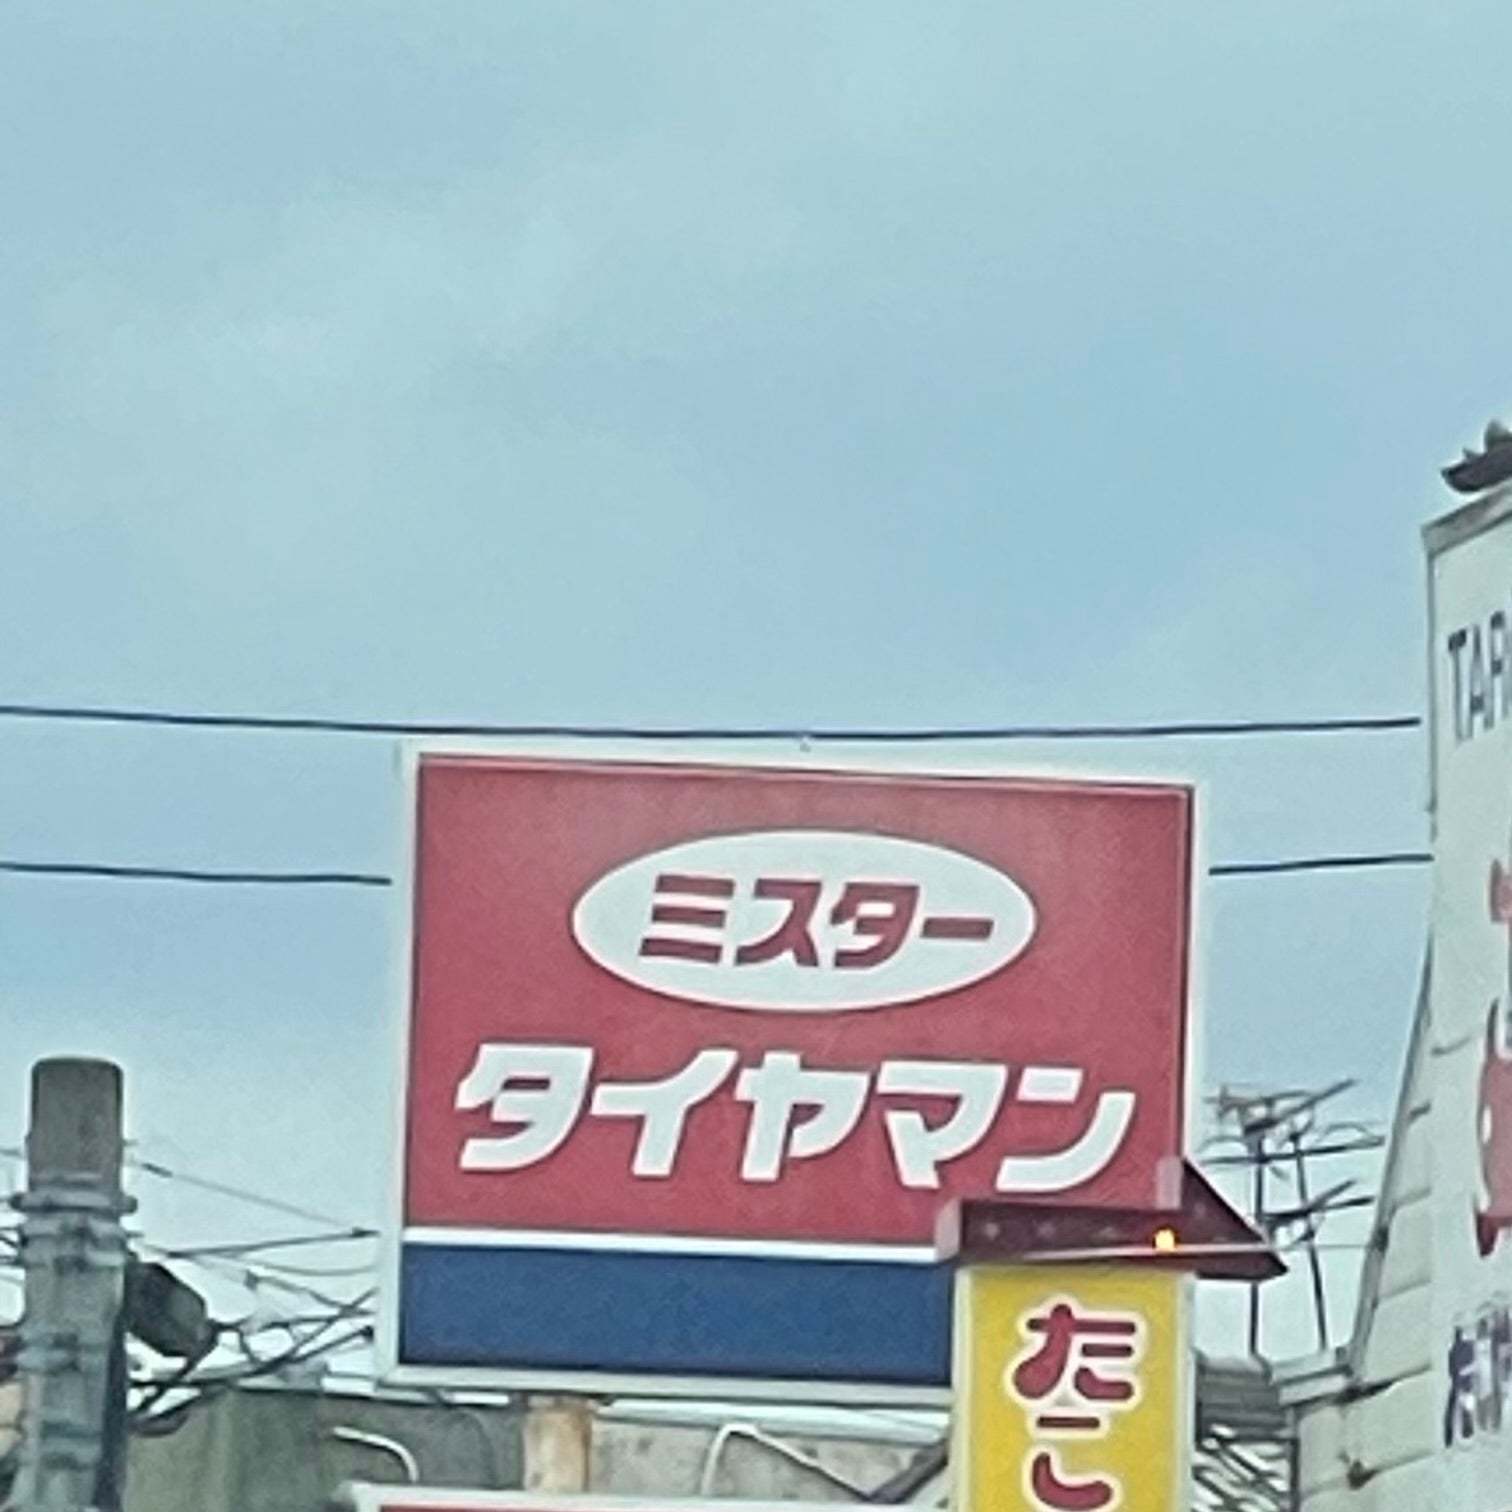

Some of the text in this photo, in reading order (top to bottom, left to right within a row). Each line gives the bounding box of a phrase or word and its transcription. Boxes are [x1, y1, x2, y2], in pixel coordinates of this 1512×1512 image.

[639, 873, 994, 970] ミスター
[454, 1042, 1137, 1193] タイヤマン
